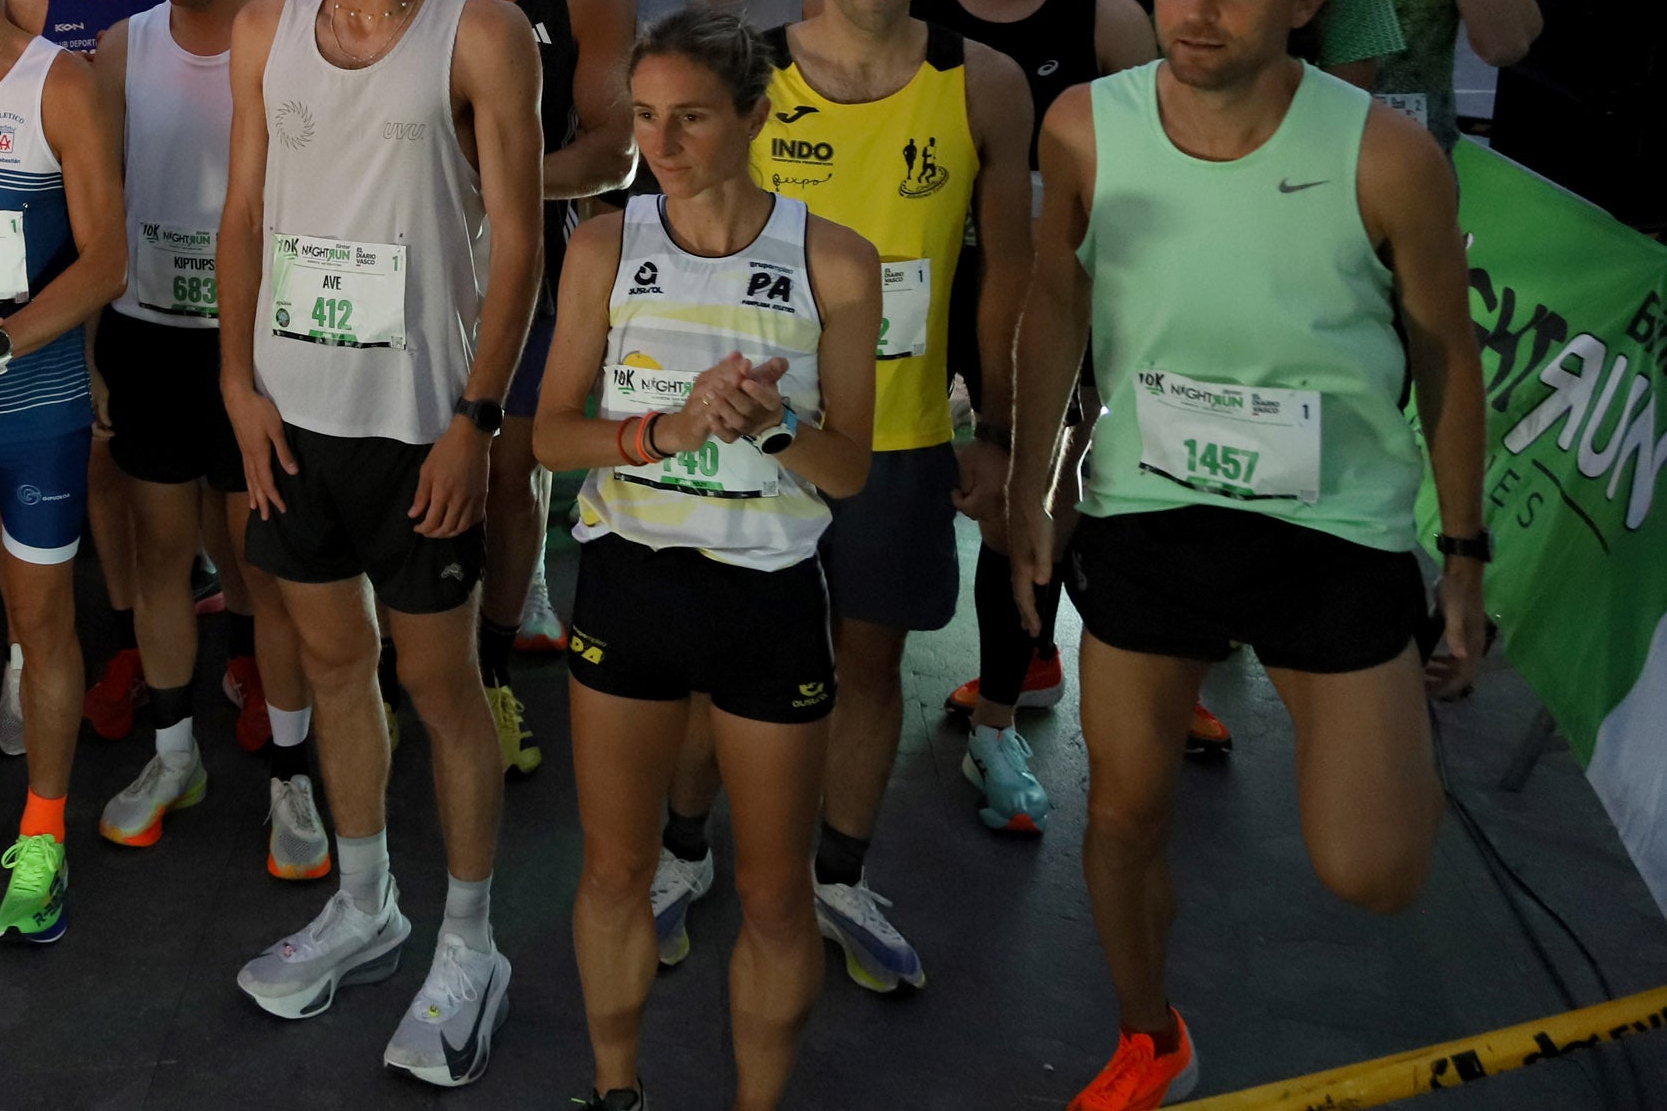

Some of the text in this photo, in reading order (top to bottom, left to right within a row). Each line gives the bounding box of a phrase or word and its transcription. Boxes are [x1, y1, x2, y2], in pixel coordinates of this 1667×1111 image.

[772, 138, 834, 161] INDO
[10, 219, 17, 234] 1
[142, 224, 160, 241] 10K
[278, 238, 299, 257] 10K
[356, 252, 376, 260] DIARIO
[357, 258, 376, 266] VASCO
[392, 255, 399, 272] 1
[322, 274, 342, 290] AVE
[918, 269, 924, 283] 1
[173, 275, 217, 304] 683
[747, 272, 792, 302] PA
[311, 297, 353, 330] 412
[613, 368, 635, 391] 10K
[1138, 372, 1165, 393] 10K
[1301, 404, 1310, 420] 1
[1183, 438, 1260, 484] 1457
